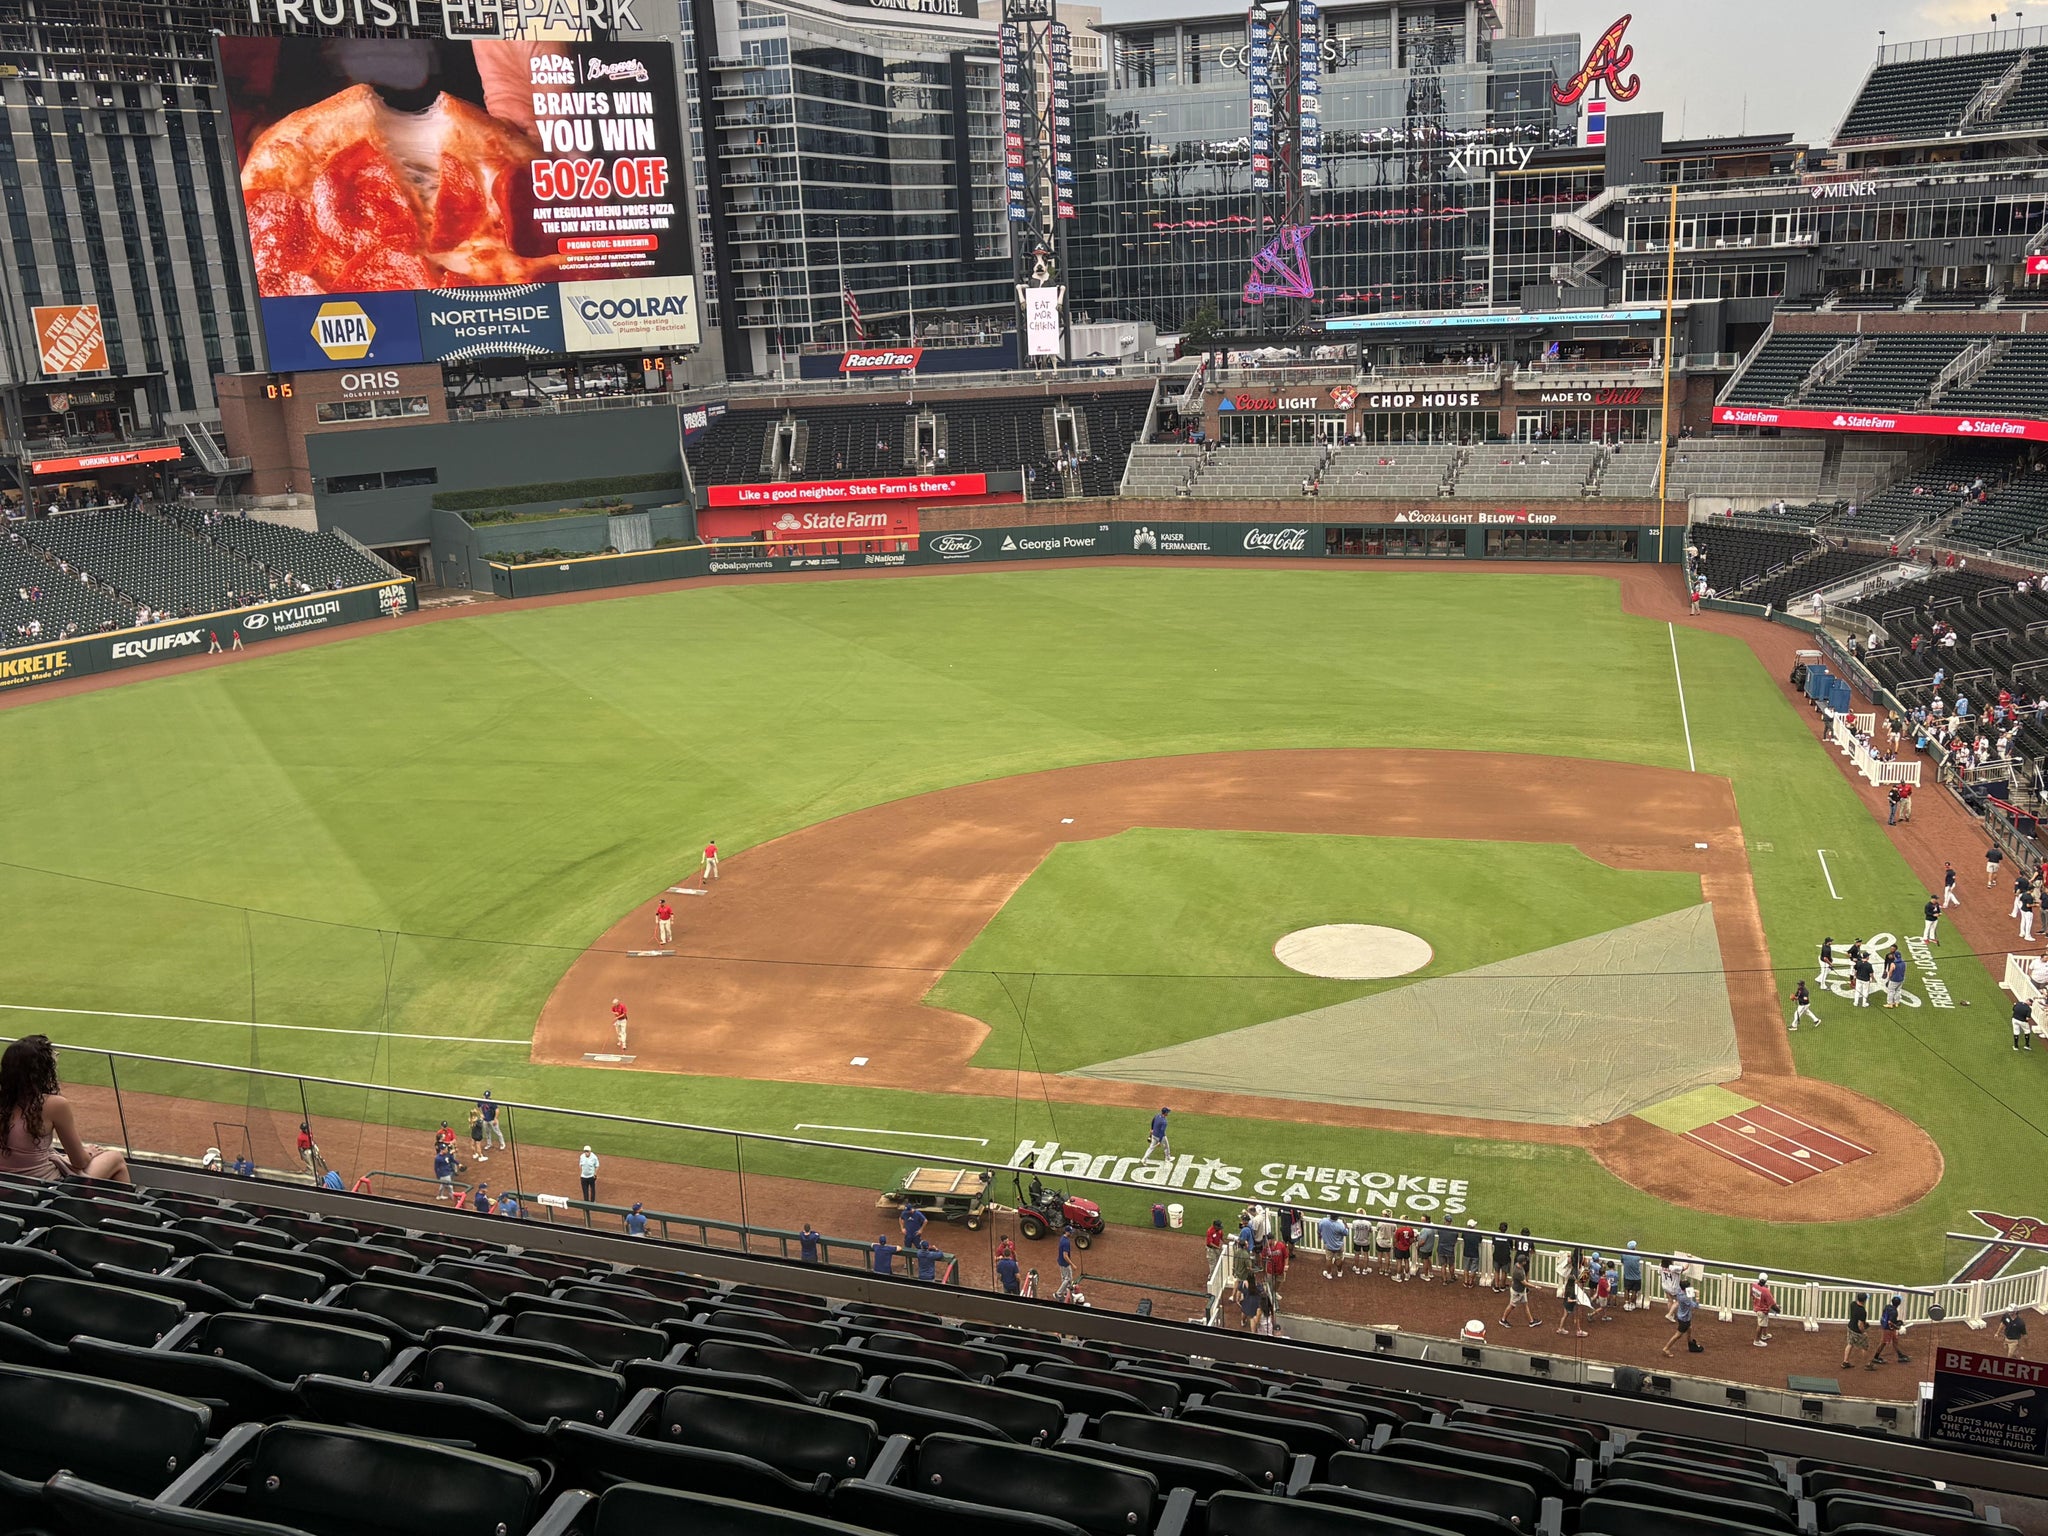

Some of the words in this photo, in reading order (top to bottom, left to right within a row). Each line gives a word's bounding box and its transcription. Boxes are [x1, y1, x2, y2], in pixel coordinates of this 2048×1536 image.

[520, 0, 641, 30] PARK
[1252, 10, 1266, 20] 1996
[1301, 5, 1315, 14] 1997
[1002, 27, 1016, 38] 1872
[1052, 25, 1065, 35] 1873
[1253, 29, 1267, 38] 1998
[1301, 24, 1316, 33] 1999
[1003, 45, 1017, 56] 1874
[1052, 43, 1066, 54] 1875
[1253, 47, 1267, 57] 2000
[1301, 43, 1316, 52] 2001
[530, 54, 574, 71] PAPA
[1053, 62, 1067, 72] 1878
[1302, 62, 1316, 71] 2003
[587, 57, 638, 80] Braves
[1003, 64, 1017, 75] 1877
[1253, 66, 1267, 76] 2002
[530, 71, 576, 85] JOHNS
[1004, 82, 1019, 92] 1883
[1054, 80, 1068, 90] 1891
[1253, 85, 1268, 94] 2004
[1302, 81, 1316, 90] 2005
[532, 92, 610, 115] BRAVES
[613, 92, 654, 115] WIN
[1006, 100, 1020, 110] 1892
[1055, 98, 1069, 108] 1893
[1254, 103, 1268, 113] 2010
[1302, 99, 1316, 108] 2012
[1007, 118, 1021, 128] 1897
[1056, 116, 1070, 126] 1898
[1254, 122, 1268, 131] 2013
[1302, 118, 1316, 127] 2018
[535, 119, 594, 152] YOU
[598, 118, 656, 151] WIN
[1056, 134, 1070, 144] 1948
[1007, 136, 1021, 146] 1914
[1255, 140, 1268, 149] 2019
[1302, 137, 1317, 146] 2020
[1008, 154, 1022, 164] 1957
[1057, 152, 1071, 162] 1958
[1302, 155, 1317, 164] 2022
[1448, 142, 1535, 174] xfinity
[1254, 159, 1268, 168] 2021
[531, 159, 612, 200] 50%
[613, 157, 669, 198] OFF
[1009, 172, 1023, 183] 1969
[1058, 170, 1072, 180] 1982
[1303, 173, 1316, 182] 2024
[1254, 178, 1268, 187] 2023
[1010, 190, 1024, 200] 1991
[1059, 188, 1072, 198] 1992
[1824, 182, 1877, 198] MILNER
[533, 208, 552, 219] ANY
[553, 206, 594, 218] REGULAR
[595, 206, 621, 217] MENU
[622, 205, 649, 216] PRICE
[650, 204, 675, 215] PIZZA
[1010, 207, 1025, 218] 1993
[1059, 205, 1073, 215] 1995
[542, 222, 560, 233] THE
[561, 222, 580, 232] DAY
[580, 220, 607, 232] AFTER
[608, 220, 616, 230] A
[616, 219, 650, 230] BRAVES
[650, 218, 669, 229] WIN
[566, 242, 591, 250] PROMO
[580, 295, 688, 320] COOLRAY
[1035, 301, 1050, 310] EAT
[430, 305, 550, 326] NORTHSIDE
[1034, 310, 1052, 320] MOR
[44, 313, 70, 340] THE
[321, 317, 367, 343] NAPA
[455, 324, 531, 338] HOSPITAL
[1029, 321, 1056, 331] CHIKIN
[43, 305, 99, 373] HOME
[69, 329, 103, 371] DEPOT
[643, 358, 664, 371] 0:15
[846, 352, 914, 367] RaceTrac
[341, 371, 400, 391] ORIS
[266, 384, 292, 399] 0:15
[1541, 393, 1574, 402] MADE
[1576, 392, 1592, 402] TO
[1595, 388, 1644, 404] Chill
[69, 393, 115, 405] CLUBHOUSE
[1235, 394, 1278, 411] Coors
[1278, 398, 1317, 410] LIGHT
[1370, 394, 1416, 408] CHOP
[1422, 393, 1480, 406] HOUSE
[78, 456, 110, 467] WORKING
[110, 455, 119, 464] ON
[120, 454, 126, 462] A
[738, 489, 760, 500] Like
[763, 491, 770, 500] a
[772, 488, 797, 501] good
[800, 486, 848, 500] neighbor,
[849, 484, 878, 496] State
[880, 484, 907, 495] Farm
[908, 482, 918, 493] is
[1408, 510, 1442, 522] Coors
[1442, 514, 1473, 523] LIGHT
[1648, 528, 1660, 536] 325
[939, 536, 972, 551] Ford
[1020, 538, 1060, 550] Georgia
[1063, 536, 1096, 547] Power
[1160, 542, 1208, 550] PERMANENTE
[874, 554, 906, 563] National
[378, 584, 404, 600] PAPA
[272, 600, 341, 624] HYUNDAI
[274, 616, 328, 632] HyundaiUSA.com
[112, 630, 202, 659] EQUIFAX
[32, 672, 52, 681] Made
[1922, 977, 1956, 1009] FREIGHT
[1260, 1163, 1469, 1196] CHEROKEE
[1253, 1180, 1467, 1214] CASINOS
[1518, 1242, 1529, 1252] 16
[1945, 1352, 1972, 1371] BE
[1978, 1358, 2044, 1382] ALERT
[1940, 1413, 1982, 1426] OBJECTS
[1984, 1420, 2005, 1430] MAY
[2007, 1424, 2037, 1435] LEAVE
[1942, 1422, 1961, 1431] THE
[1962, 1425, 2004, 1438] PLAYING
[2006, 1432, 2033, 1442] FIELD
[1936, 1428, 1944, 1436] &
[1946, 1430, 1967, 1440] MAY
[1969, 1434, 2000, 1446] CAUSE
[2003, 1438, 2038, 1451] INJURY
